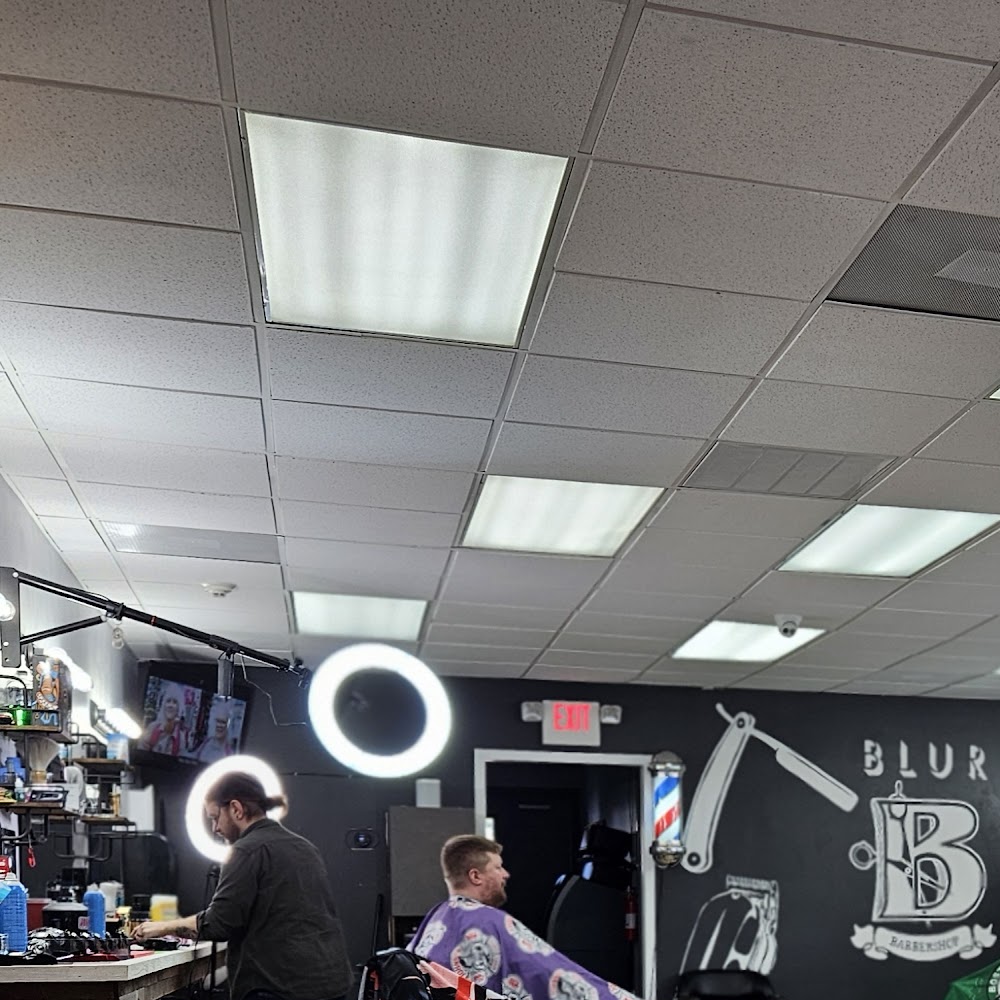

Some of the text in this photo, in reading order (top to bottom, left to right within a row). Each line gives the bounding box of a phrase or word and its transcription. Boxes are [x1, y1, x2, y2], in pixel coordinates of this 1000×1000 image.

[553, 703, 591, 731] EXIT
[863, 739, 987, 781] BLUR
[889, 936, 959, 952] BARBERSHOP
